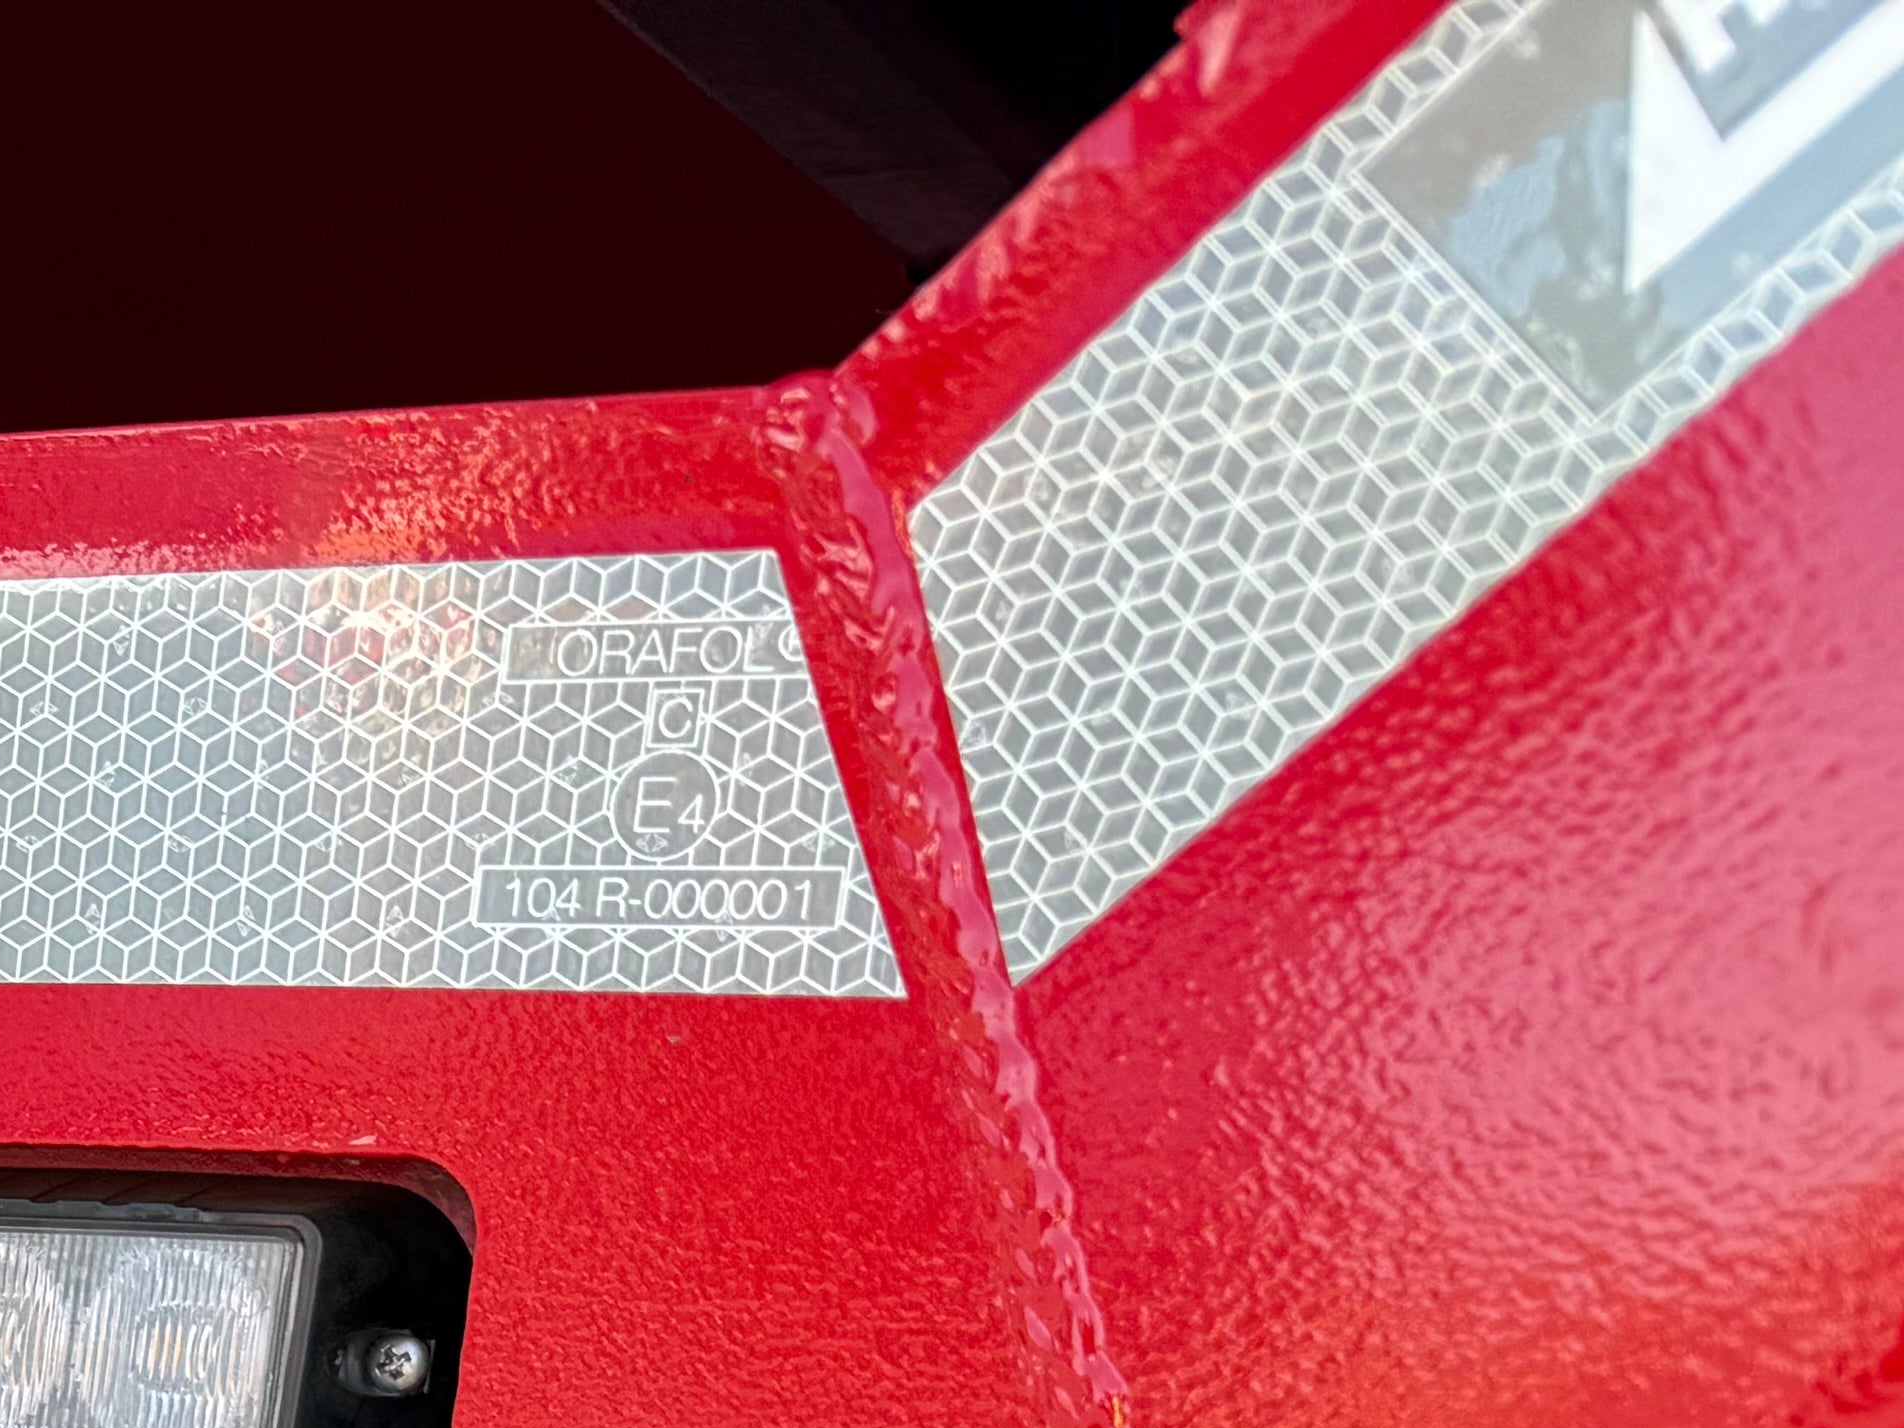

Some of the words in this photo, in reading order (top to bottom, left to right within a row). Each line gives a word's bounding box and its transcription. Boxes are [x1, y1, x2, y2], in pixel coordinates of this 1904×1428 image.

[633, 776, 705, 834] E4
[505, 877, 582, 918] 104
[595, 877, 812, 920] R-000001
